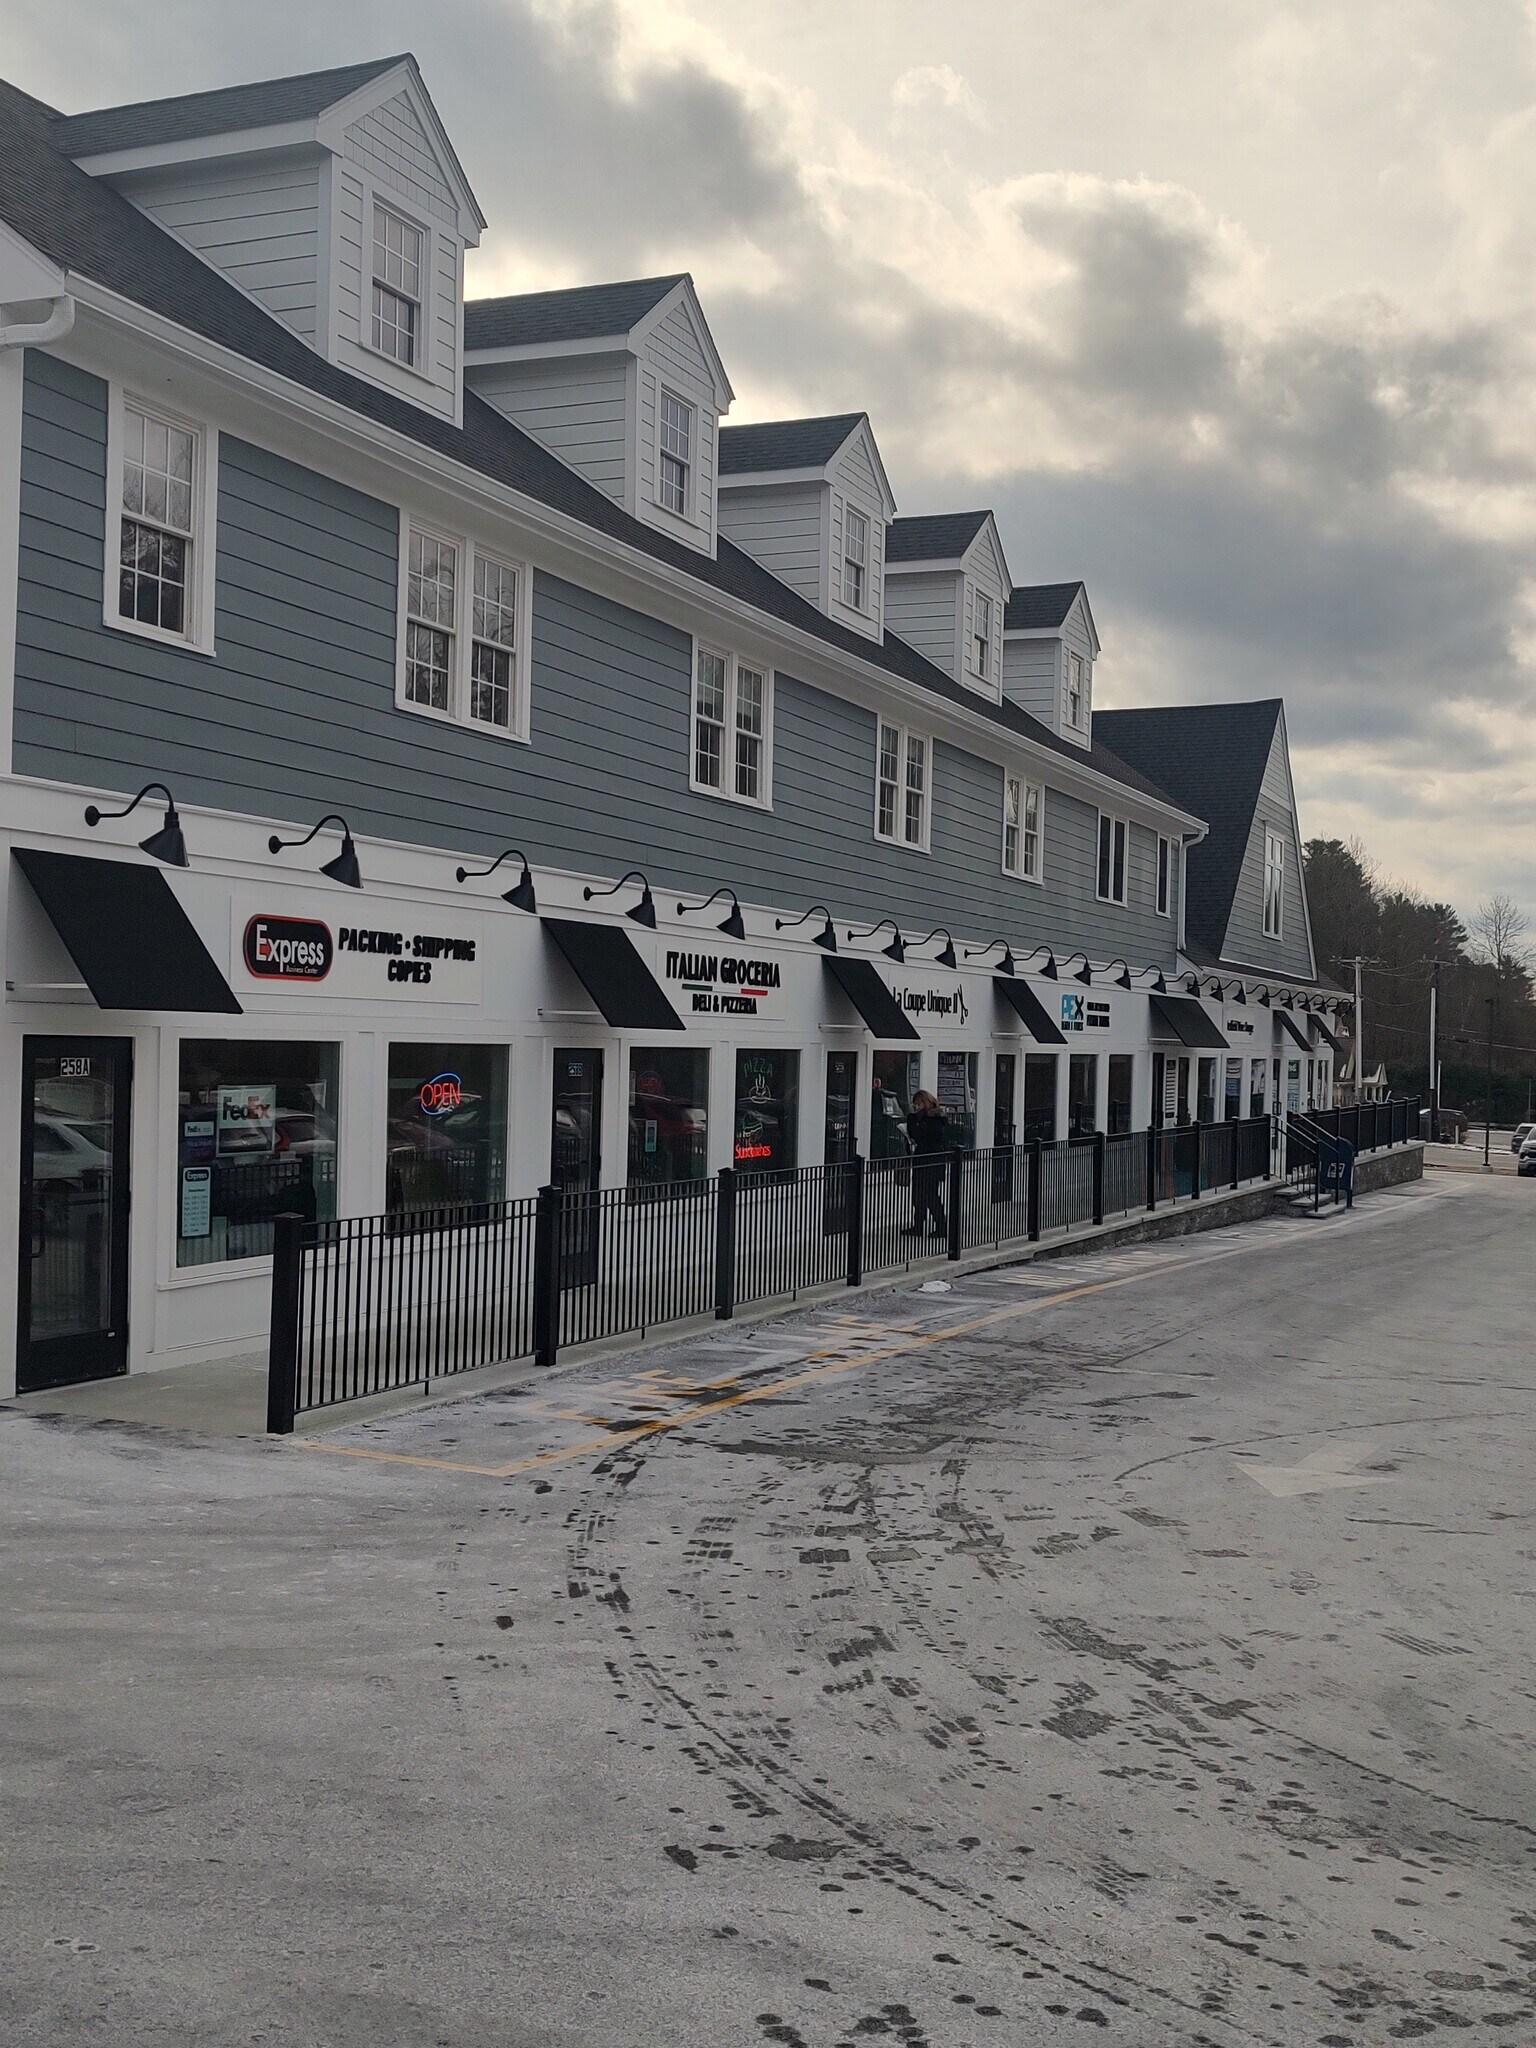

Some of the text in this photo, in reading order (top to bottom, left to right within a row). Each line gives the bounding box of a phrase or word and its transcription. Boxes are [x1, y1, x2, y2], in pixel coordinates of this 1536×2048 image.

[256, 923, 325, 973] Express
[338, 927, 476, 962] PACKING SHIPPING
[387, 958, 432, 984] COPIES
[666, 950, 781, 988] ITALIAN GROCERIA
[692, 993, 758, 1015] DELI & PIZZERIA
[904, 987, 926, 1017] Coupe
[927, 989, 952, 1019] Unique
[1061, 994, 1085, 1021] PEX
[61, 1058, 89, 1076] 258A
[222, 1095, 271, 1121] FedEx
[420, 1083, 461, 1107] OPEN
